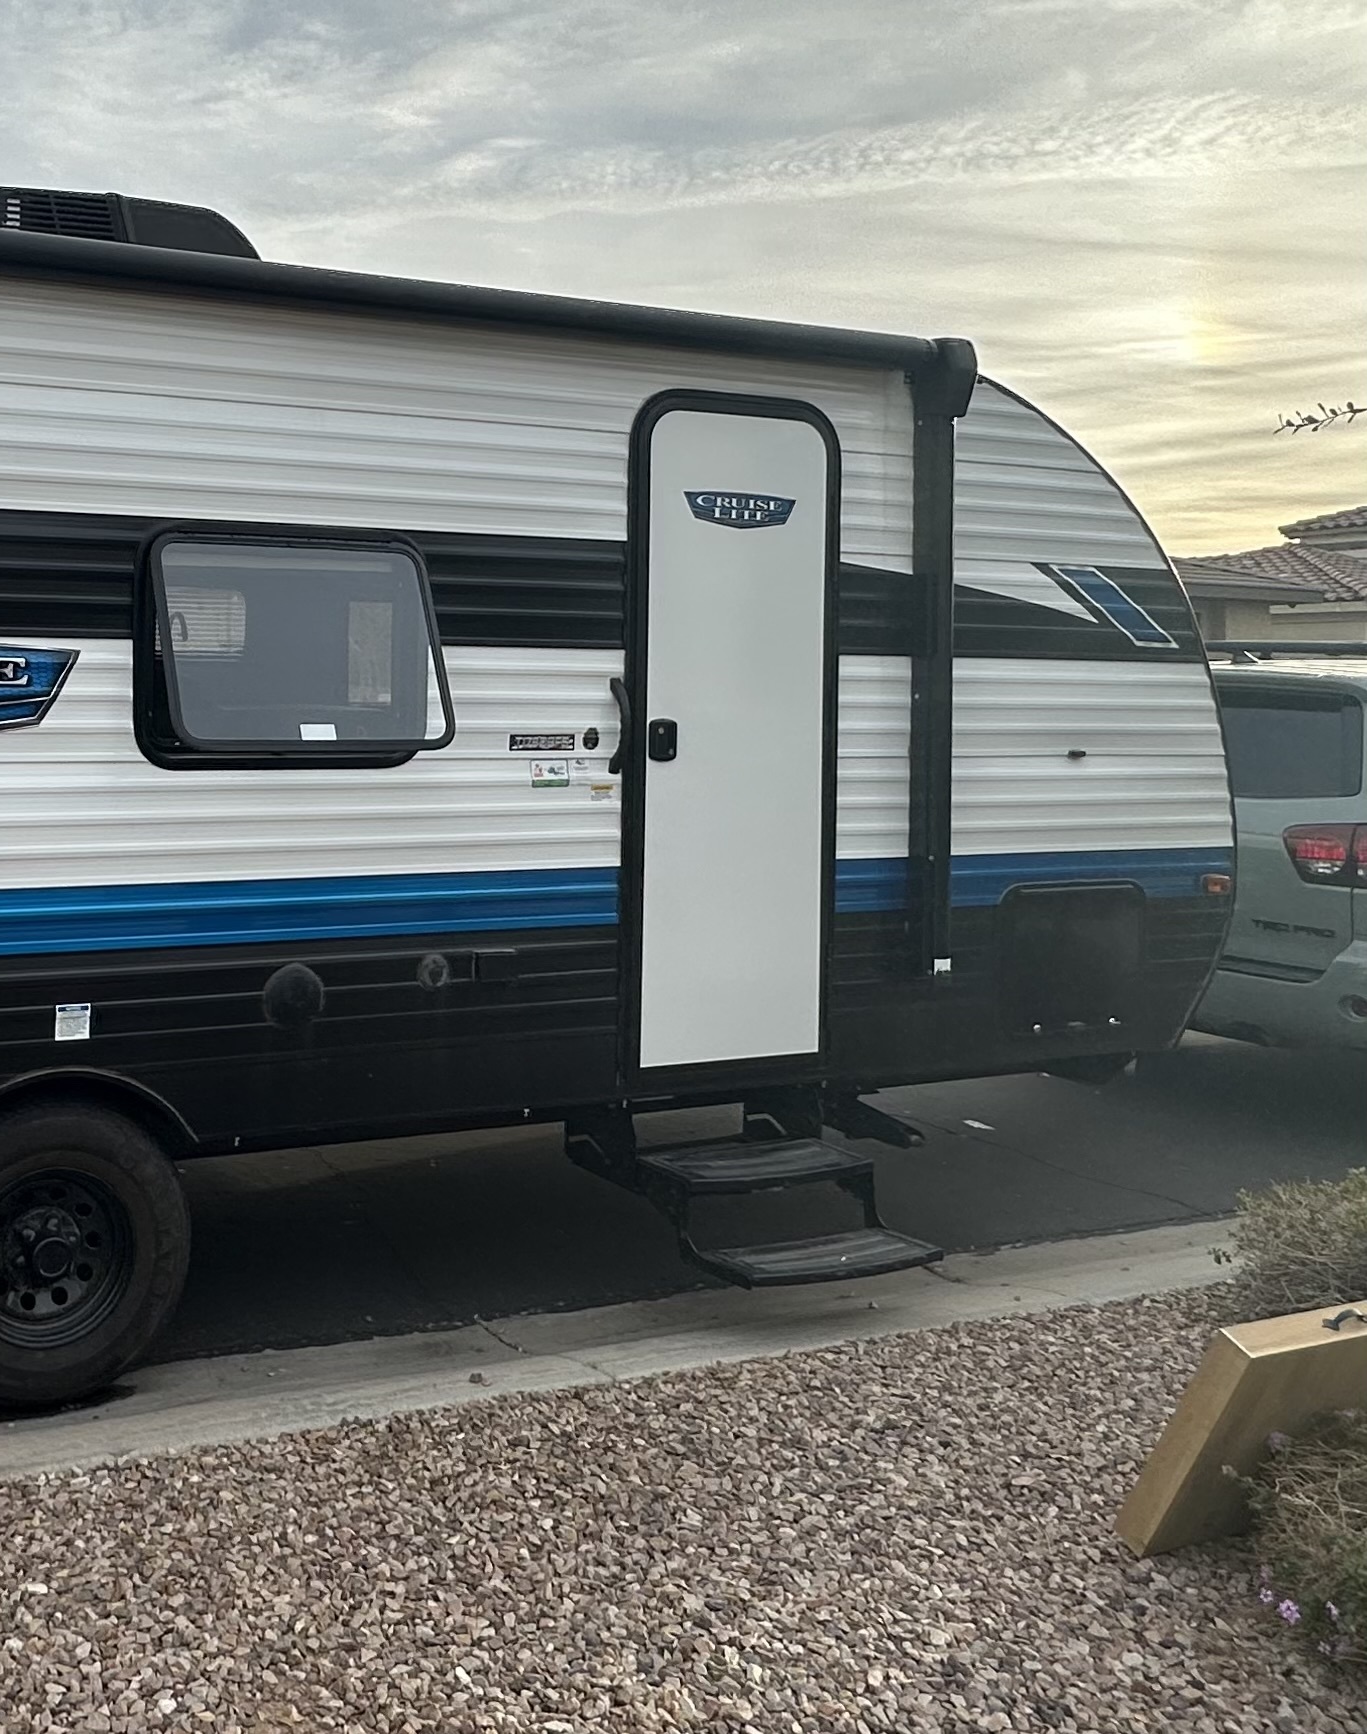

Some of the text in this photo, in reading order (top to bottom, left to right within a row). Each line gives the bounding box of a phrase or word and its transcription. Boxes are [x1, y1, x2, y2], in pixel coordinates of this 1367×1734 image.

[696, 495, 782, 511] CRUISE
[714, 507, 769, 521] LITE
[1293, 924, 1337, 938] PRO
